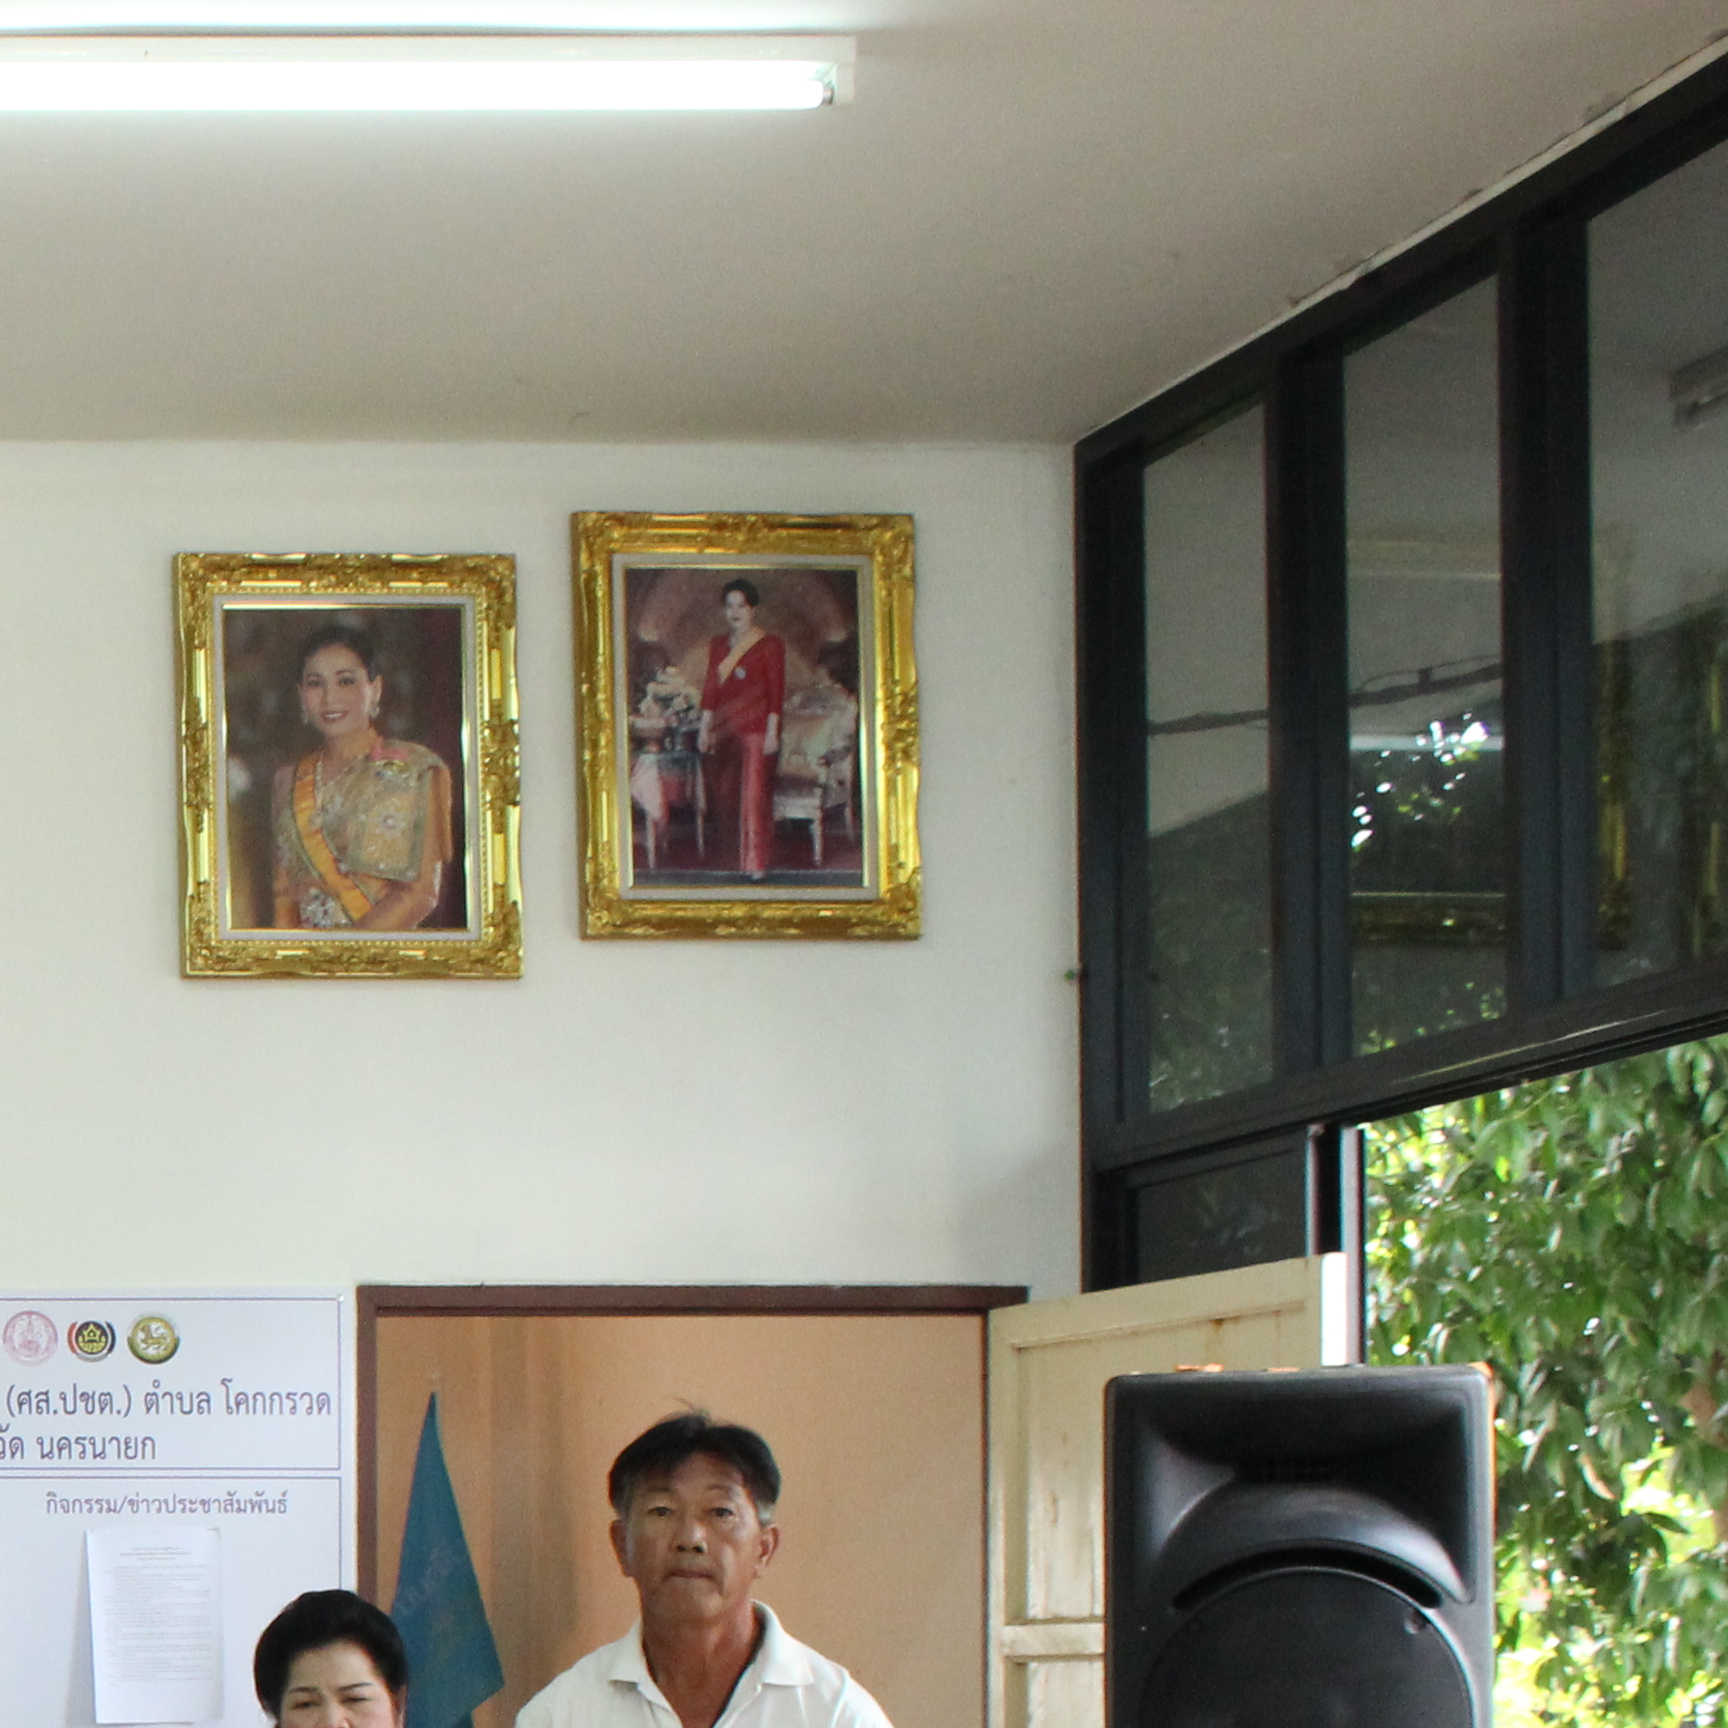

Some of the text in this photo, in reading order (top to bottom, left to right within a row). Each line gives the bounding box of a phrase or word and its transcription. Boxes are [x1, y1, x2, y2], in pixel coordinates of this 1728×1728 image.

[5, 1382, 134, 1419] (ศส.ปชต.)
[143, 1379, 212, 1416] ตำบล
[220, 1377, 332, 1416] โคกกรวด
[35, 1433, 157, 1461] นครนายก
[44, 1488, 289, 1515] กิจกรรม/ข่าวประชาสัมพันธ์
